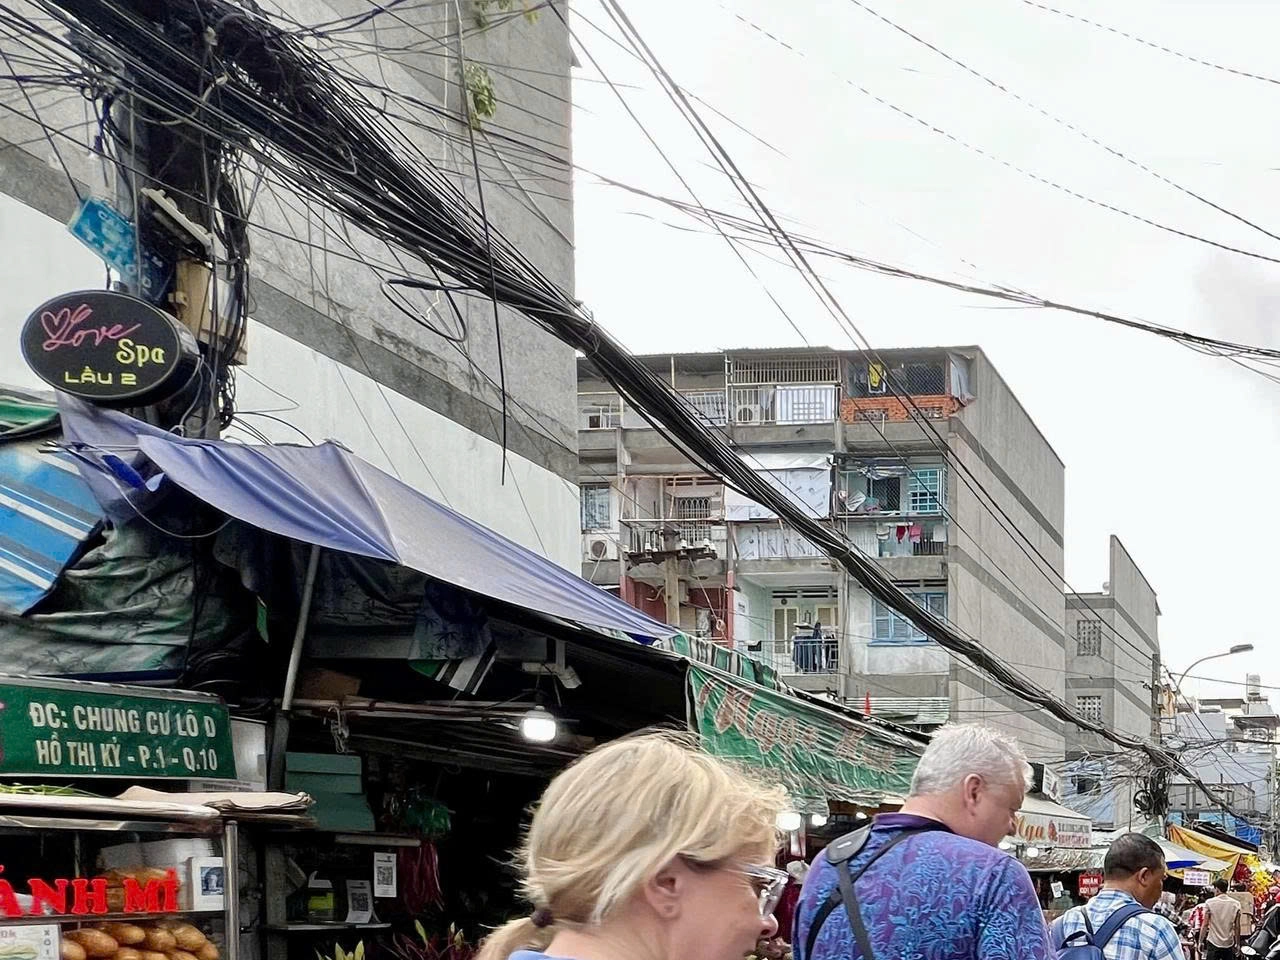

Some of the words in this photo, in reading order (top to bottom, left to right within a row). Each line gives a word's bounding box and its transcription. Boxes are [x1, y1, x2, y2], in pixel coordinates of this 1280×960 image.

[43, 304, 141, 351] Love
[116, 338, 165, 367] Spa
[120, 372, 138, 386] 2
[29, 702, 68, 729] ĐC:
[73, 705, 141, 734] CHUNG
[175, 708, 199, 737] LÔ
[203, 715, 216, 738] D
[35, 731, 62, 766] HỒ
[67, 741, 96, 772] THỊ
[138, 745, 166, 769] P.1
[183, 747, 218, 772] Q.10
